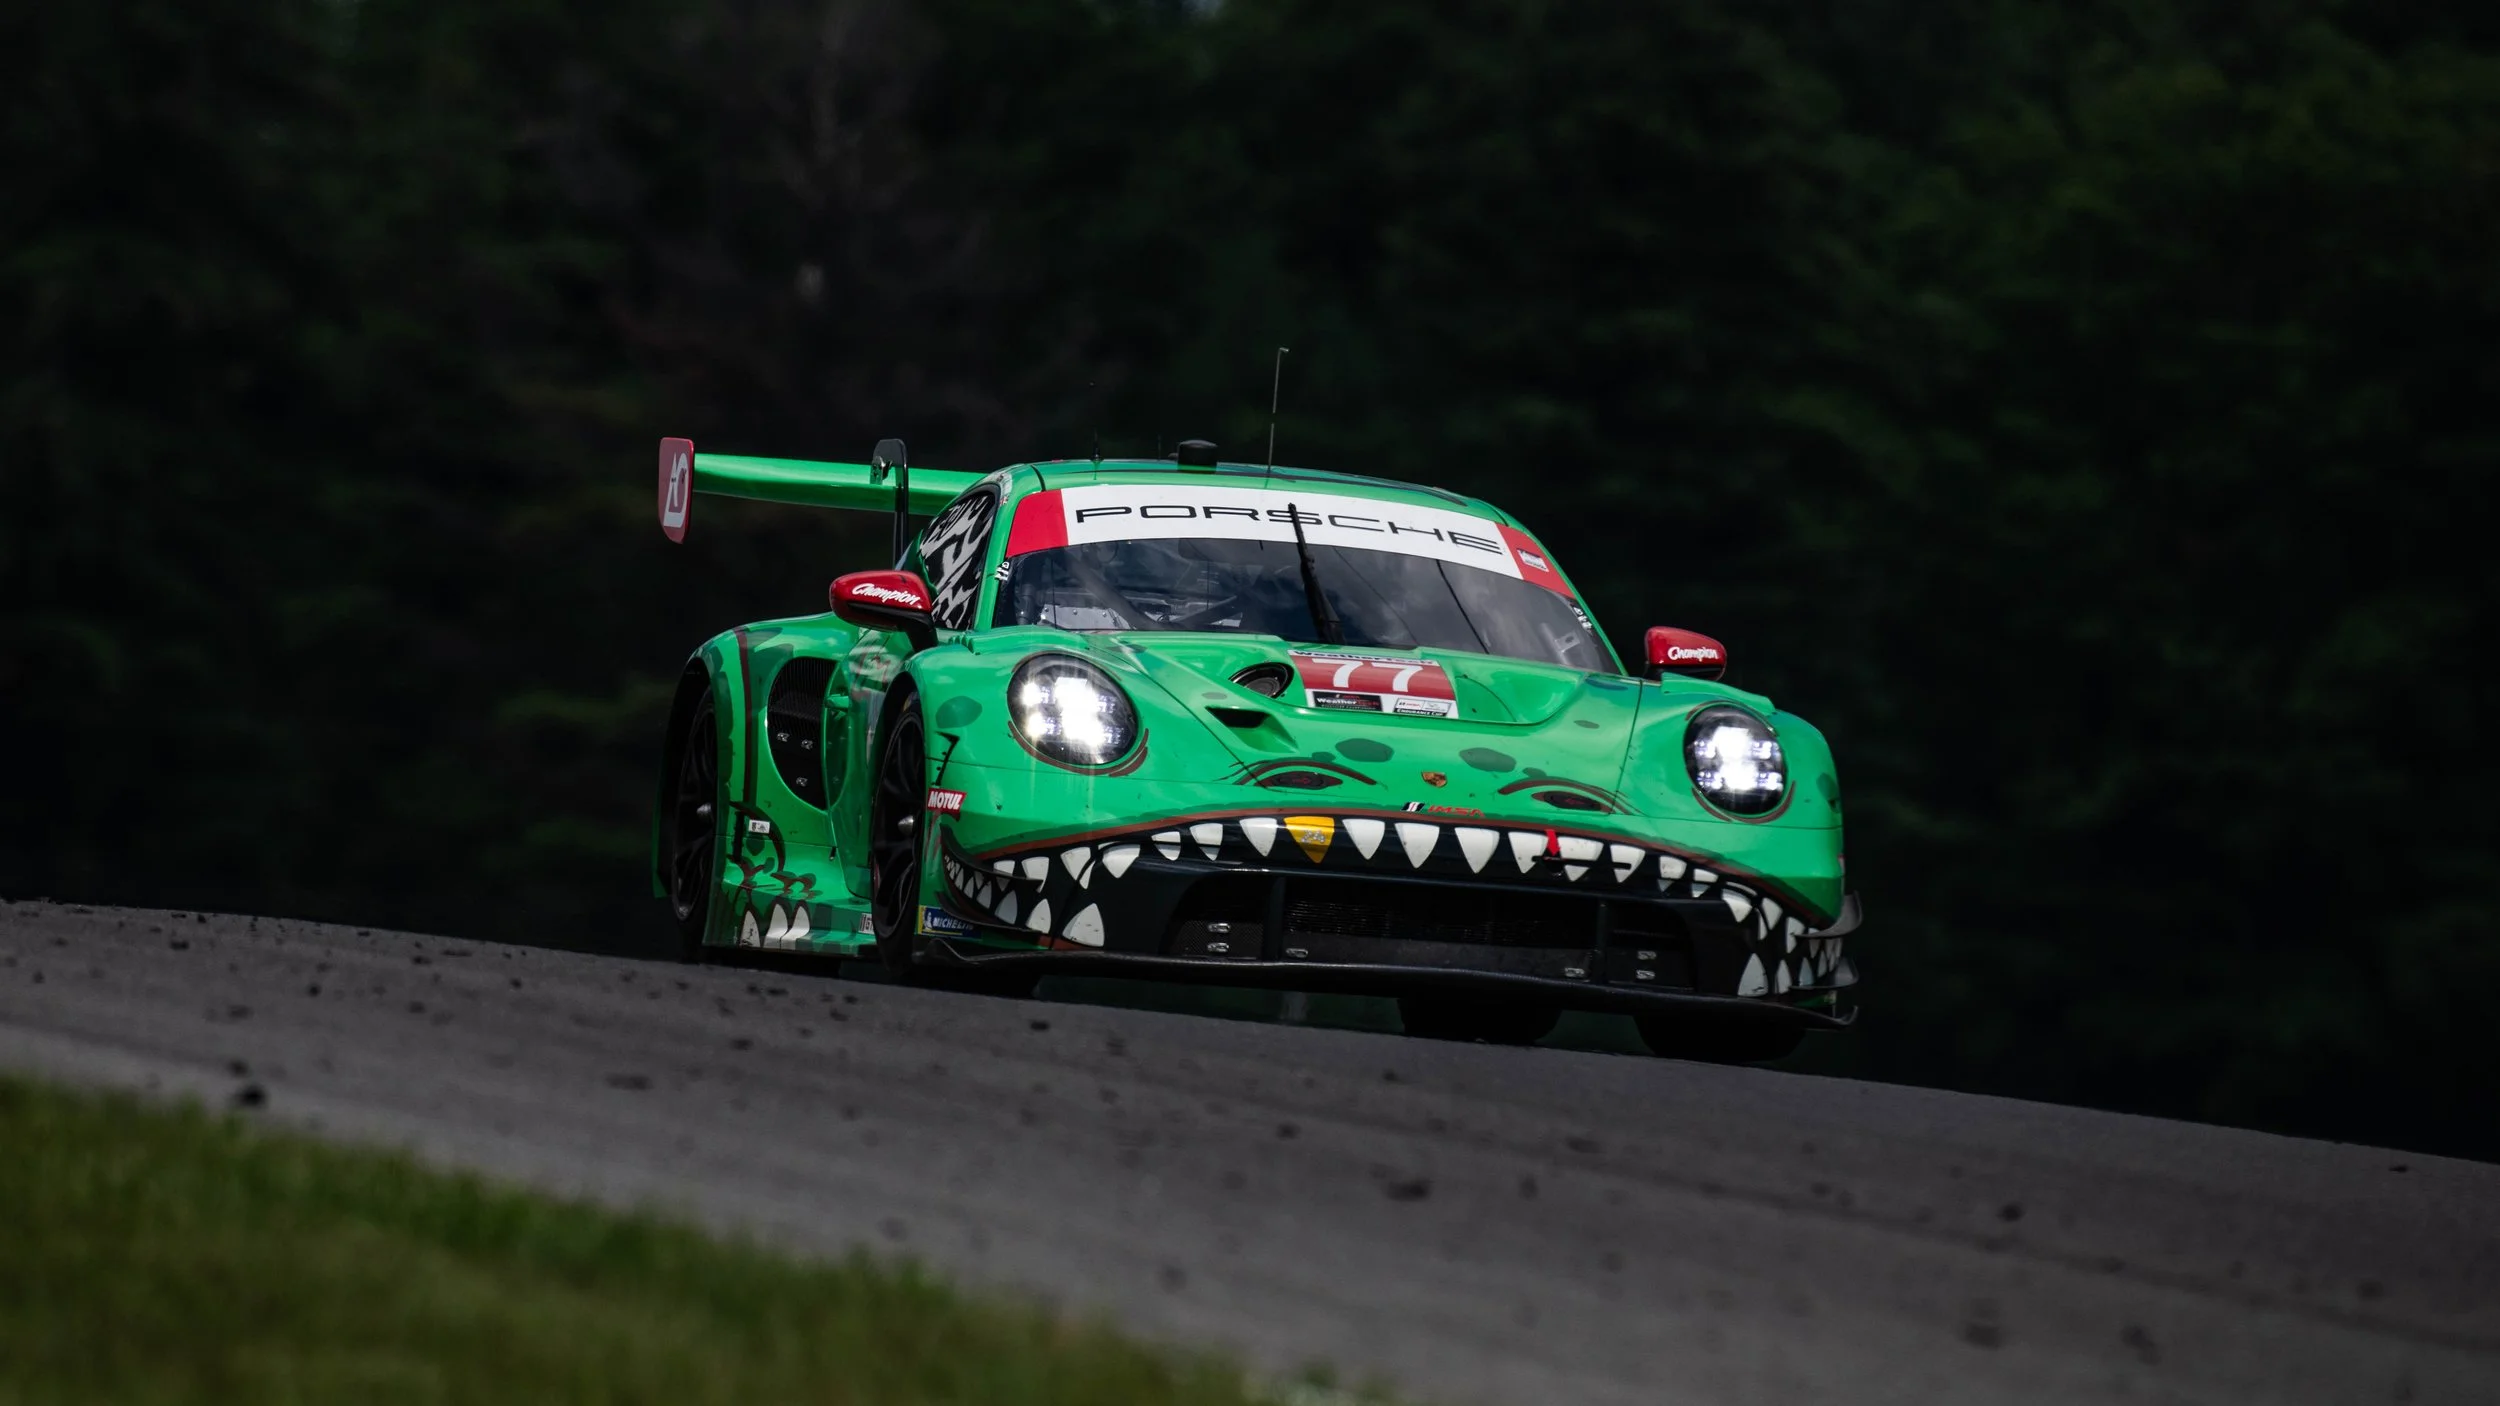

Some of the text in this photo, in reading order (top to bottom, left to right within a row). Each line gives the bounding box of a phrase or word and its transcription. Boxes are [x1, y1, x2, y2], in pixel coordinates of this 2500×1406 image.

[1076, 504, 1503, 555] PORSCHE
[852, 583, 920, 605] Champion
[1668, 646, 1719, 662] Champion
[1312, 658, 1423, 692] 77
[928, 790, 963, 810] MOTUL
